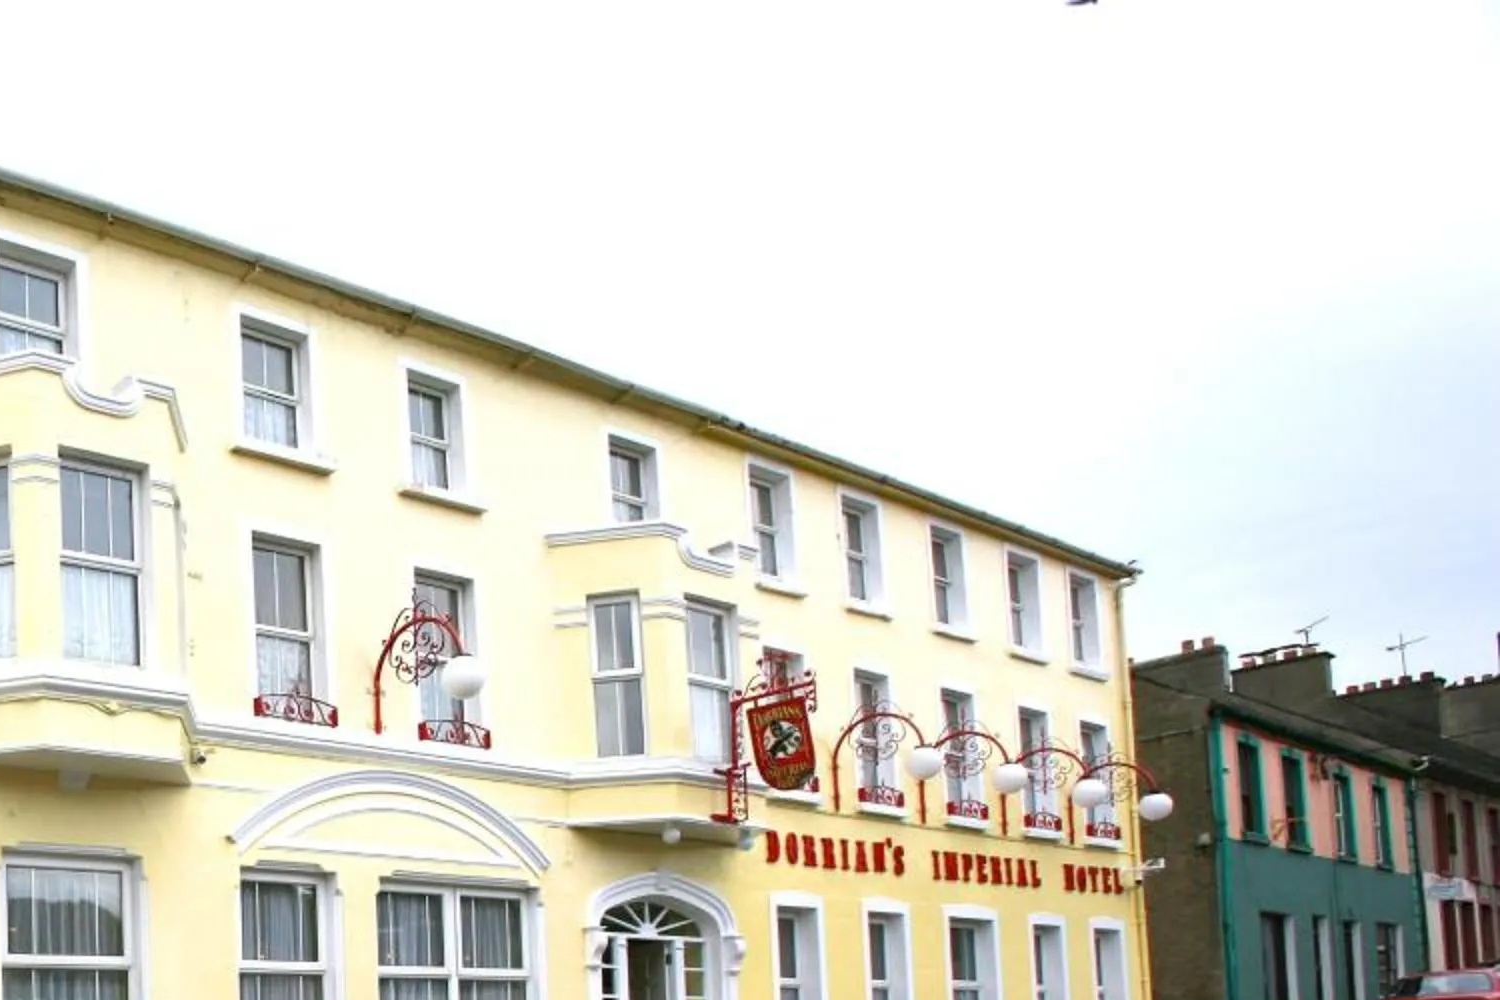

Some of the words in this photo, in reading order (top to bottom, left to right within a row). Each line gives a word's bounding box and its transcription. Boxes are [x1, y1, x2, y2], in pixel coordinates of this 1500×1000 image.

[765, 830, 905, 877] DORRIAN'S
[931, 850, 1042, 889] IMPERIAL
[1062, 863, 1124, 895] HOTEL
